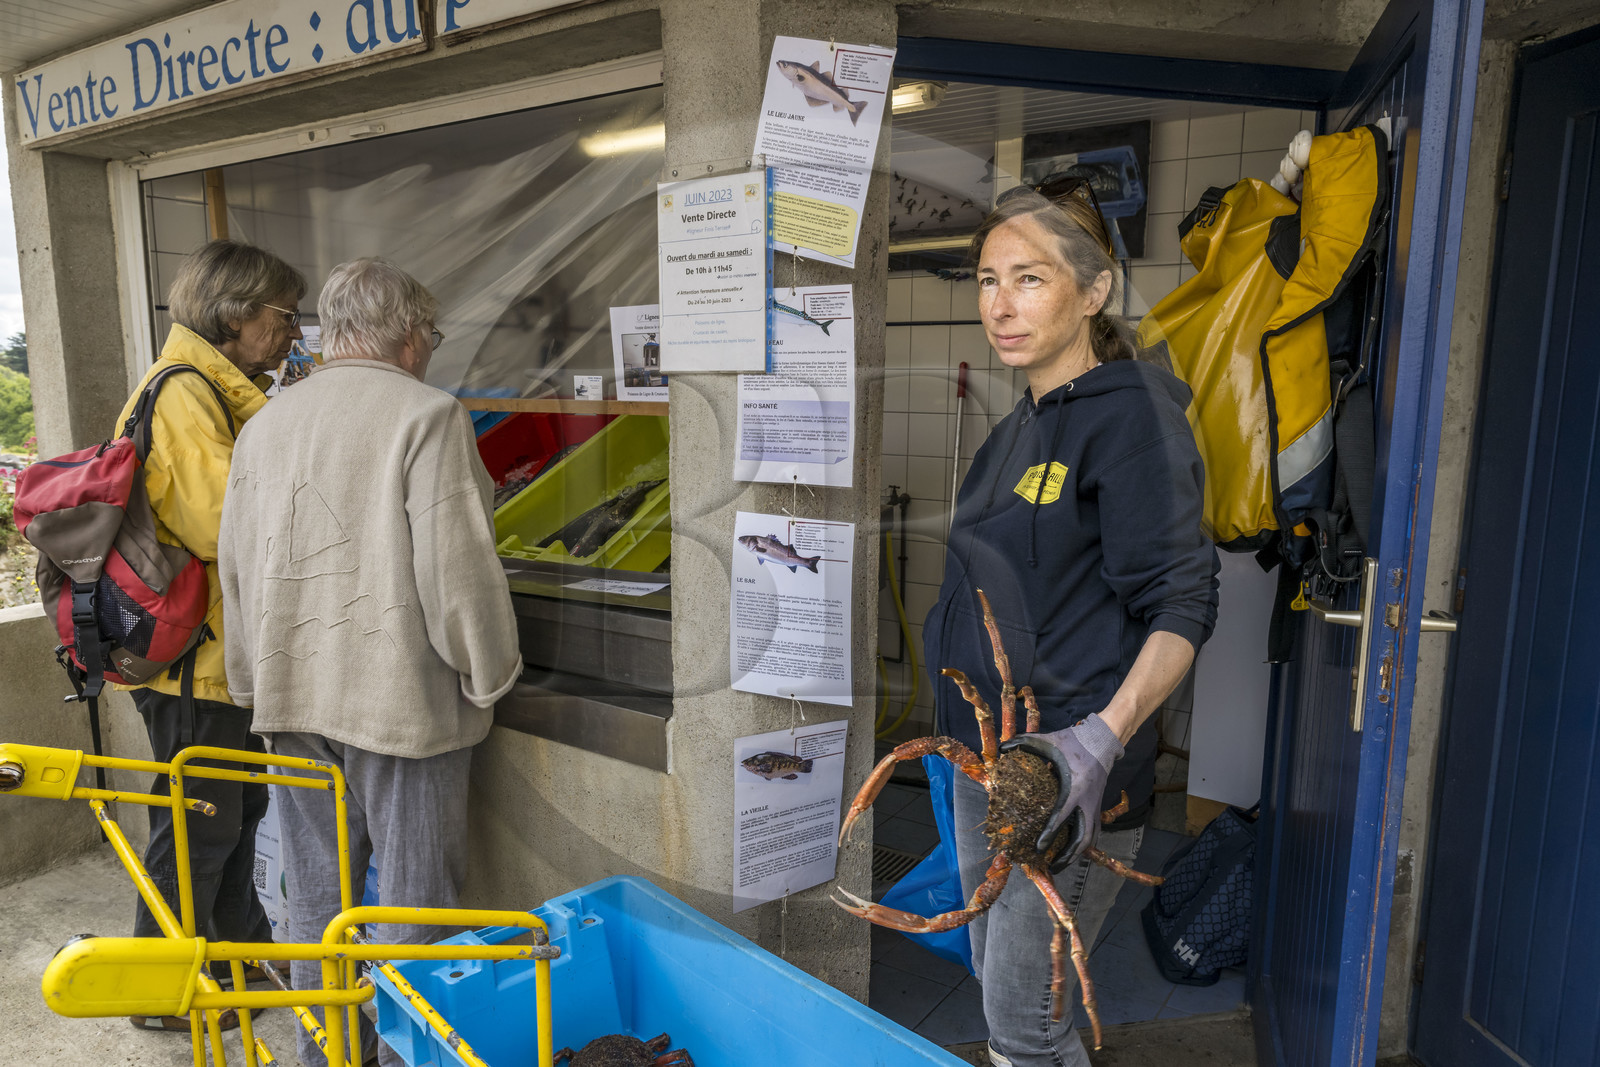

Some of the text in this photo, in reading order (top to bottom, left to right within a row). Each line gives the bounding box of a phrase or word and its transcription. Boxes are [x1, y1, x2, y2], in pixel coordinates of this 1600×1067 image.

[17, 71, 118, 138] Vente
[125, 18, 290, 111] Directe
[788, 113, 805, 122] JAUNE
[684, 189, 732, 204] JUIN 2023
[682, 210, 736, 223] Vente Directe
[726, 248, 748, 256] samedi
[1028, 470, 1064, 484] POISAILL
[750, 805, 768, 814] VIEILLE
[1173, 938, 1200, 966] HH
